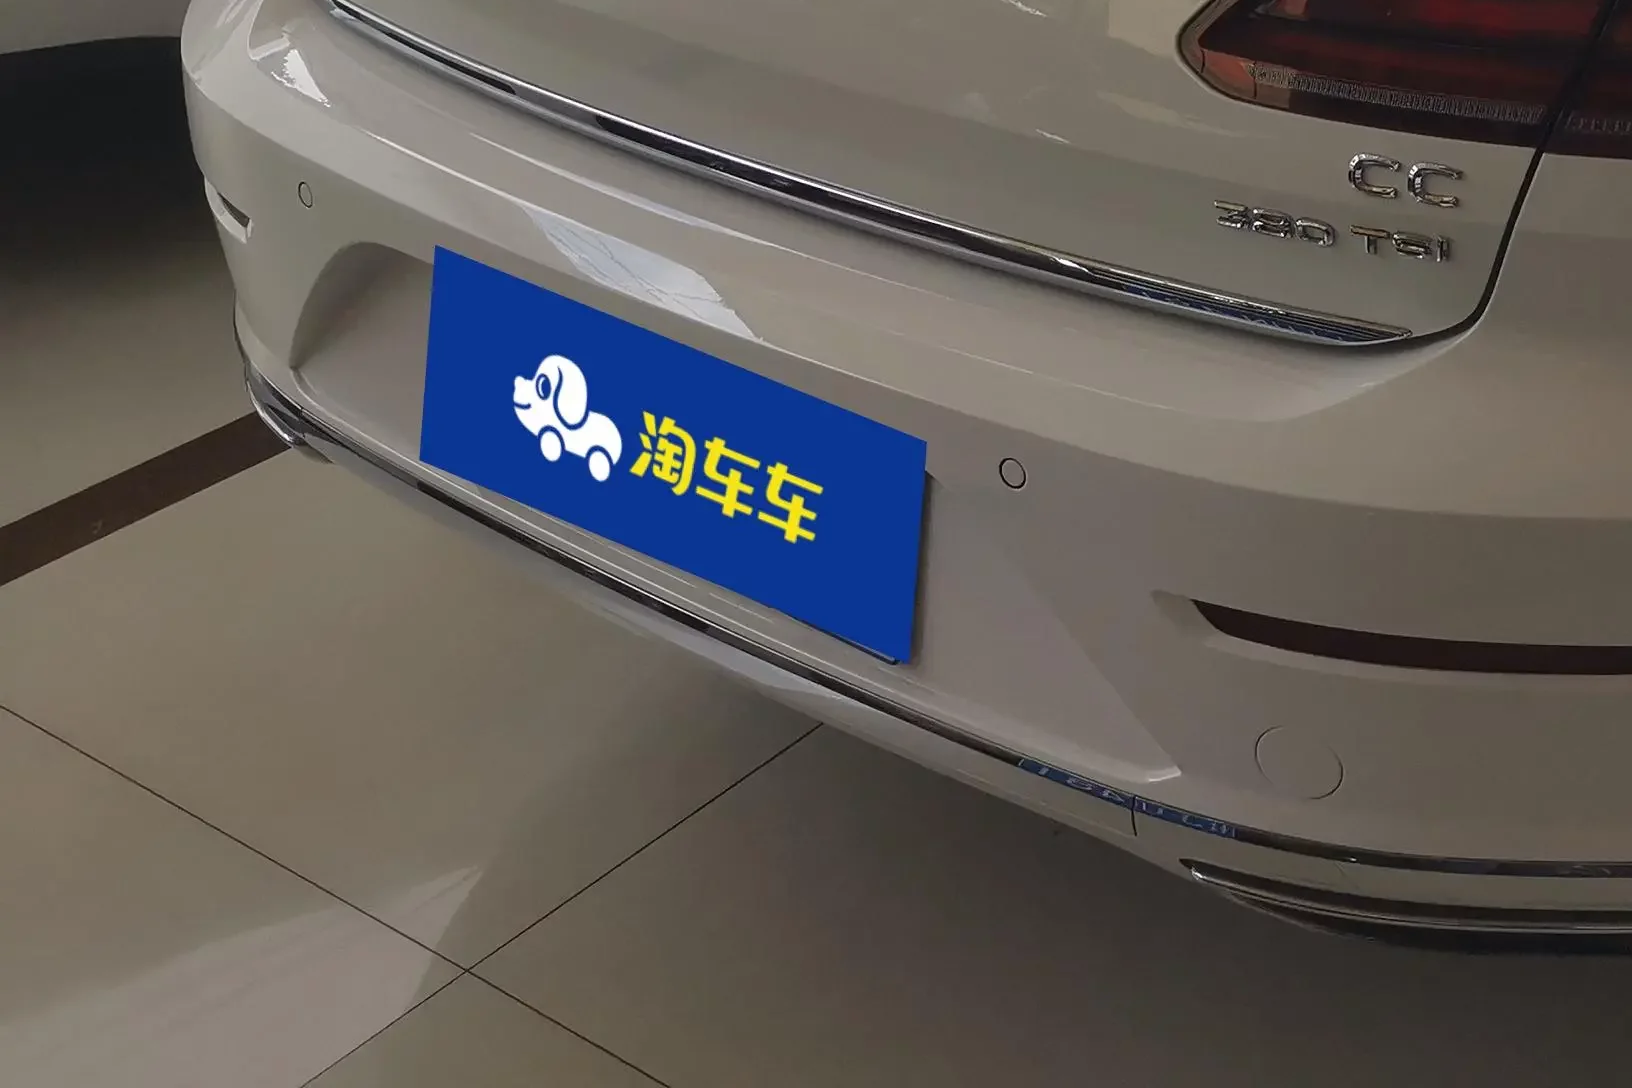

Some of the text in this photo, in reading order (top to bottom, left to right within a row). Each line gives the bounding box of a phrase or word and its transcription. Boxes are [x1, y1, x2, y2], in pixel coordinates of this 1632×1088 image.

[1348, 151, 1464, 209] CC
[1213, 199, 1451, 263] 380 TSI
